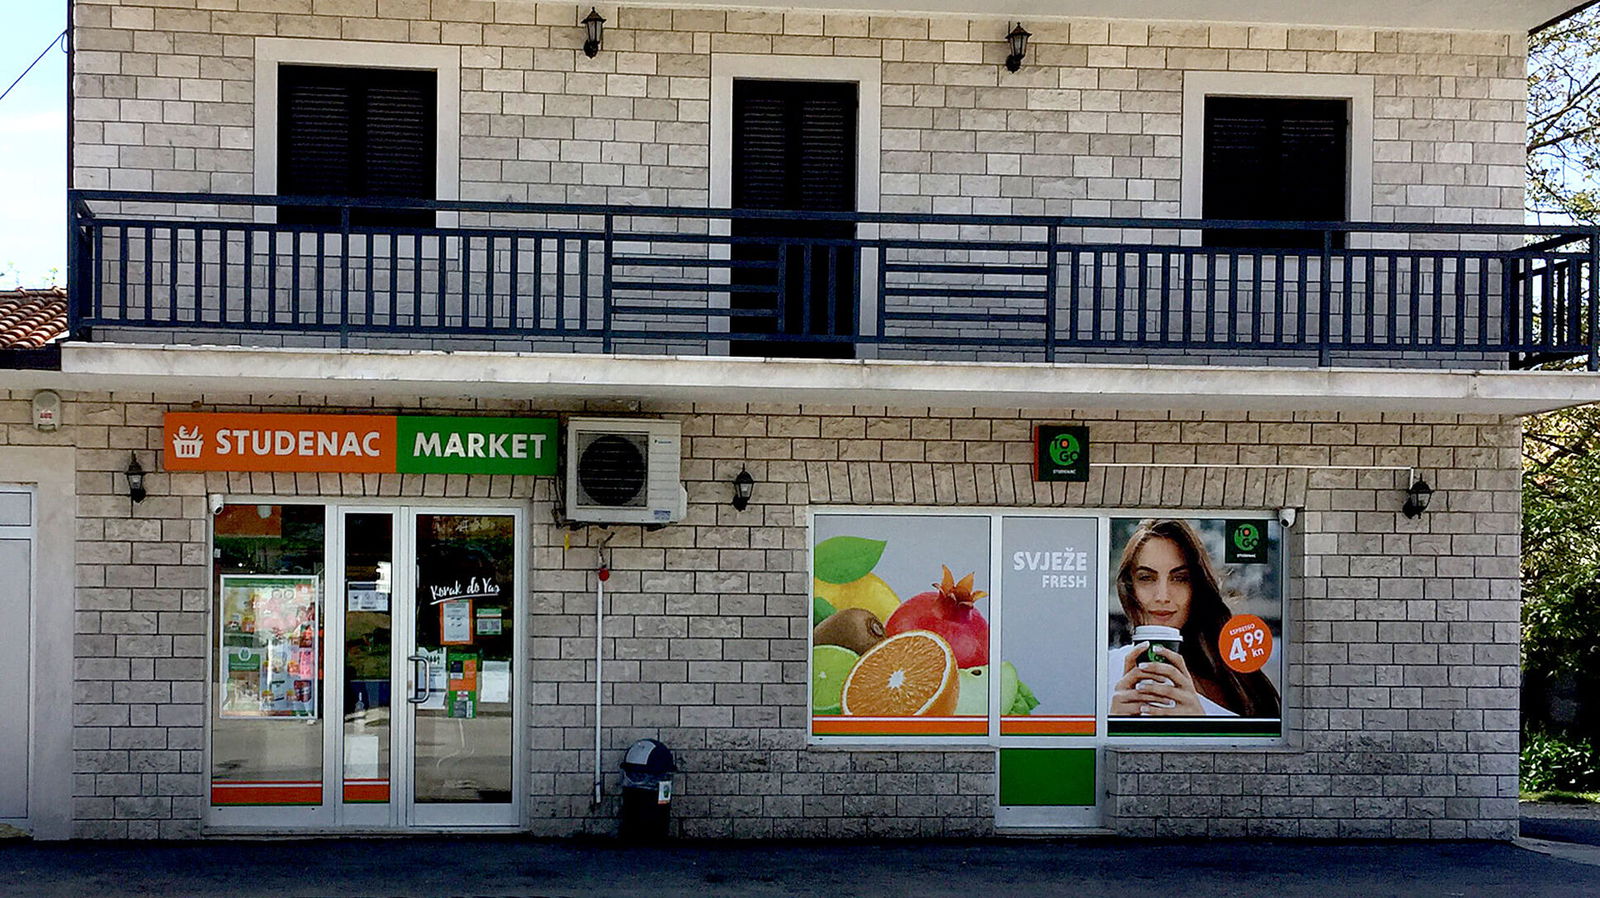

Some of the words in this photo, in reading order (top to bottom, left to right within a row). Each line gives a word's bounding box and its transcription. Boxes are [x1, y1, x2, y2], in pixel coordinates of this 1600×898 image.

[216, 429, 380, 457] STUDENAC
[413, 432, 547, 459] MARKET
[1051, 438, 1070, 449] TO
[1060, 451, 1080, 462] GO
[1235, 527, 1251, 537] TO
[1242, 538, 1260, 547] GO
[1013, 547, 1088, 571] SVJEŽE
[1042, 575, 1087, 588] FRESH
[430, 580, 462, 600] Korak
[467, 577, 480, 594] do
[1251, 648, 1264, 657] kn
